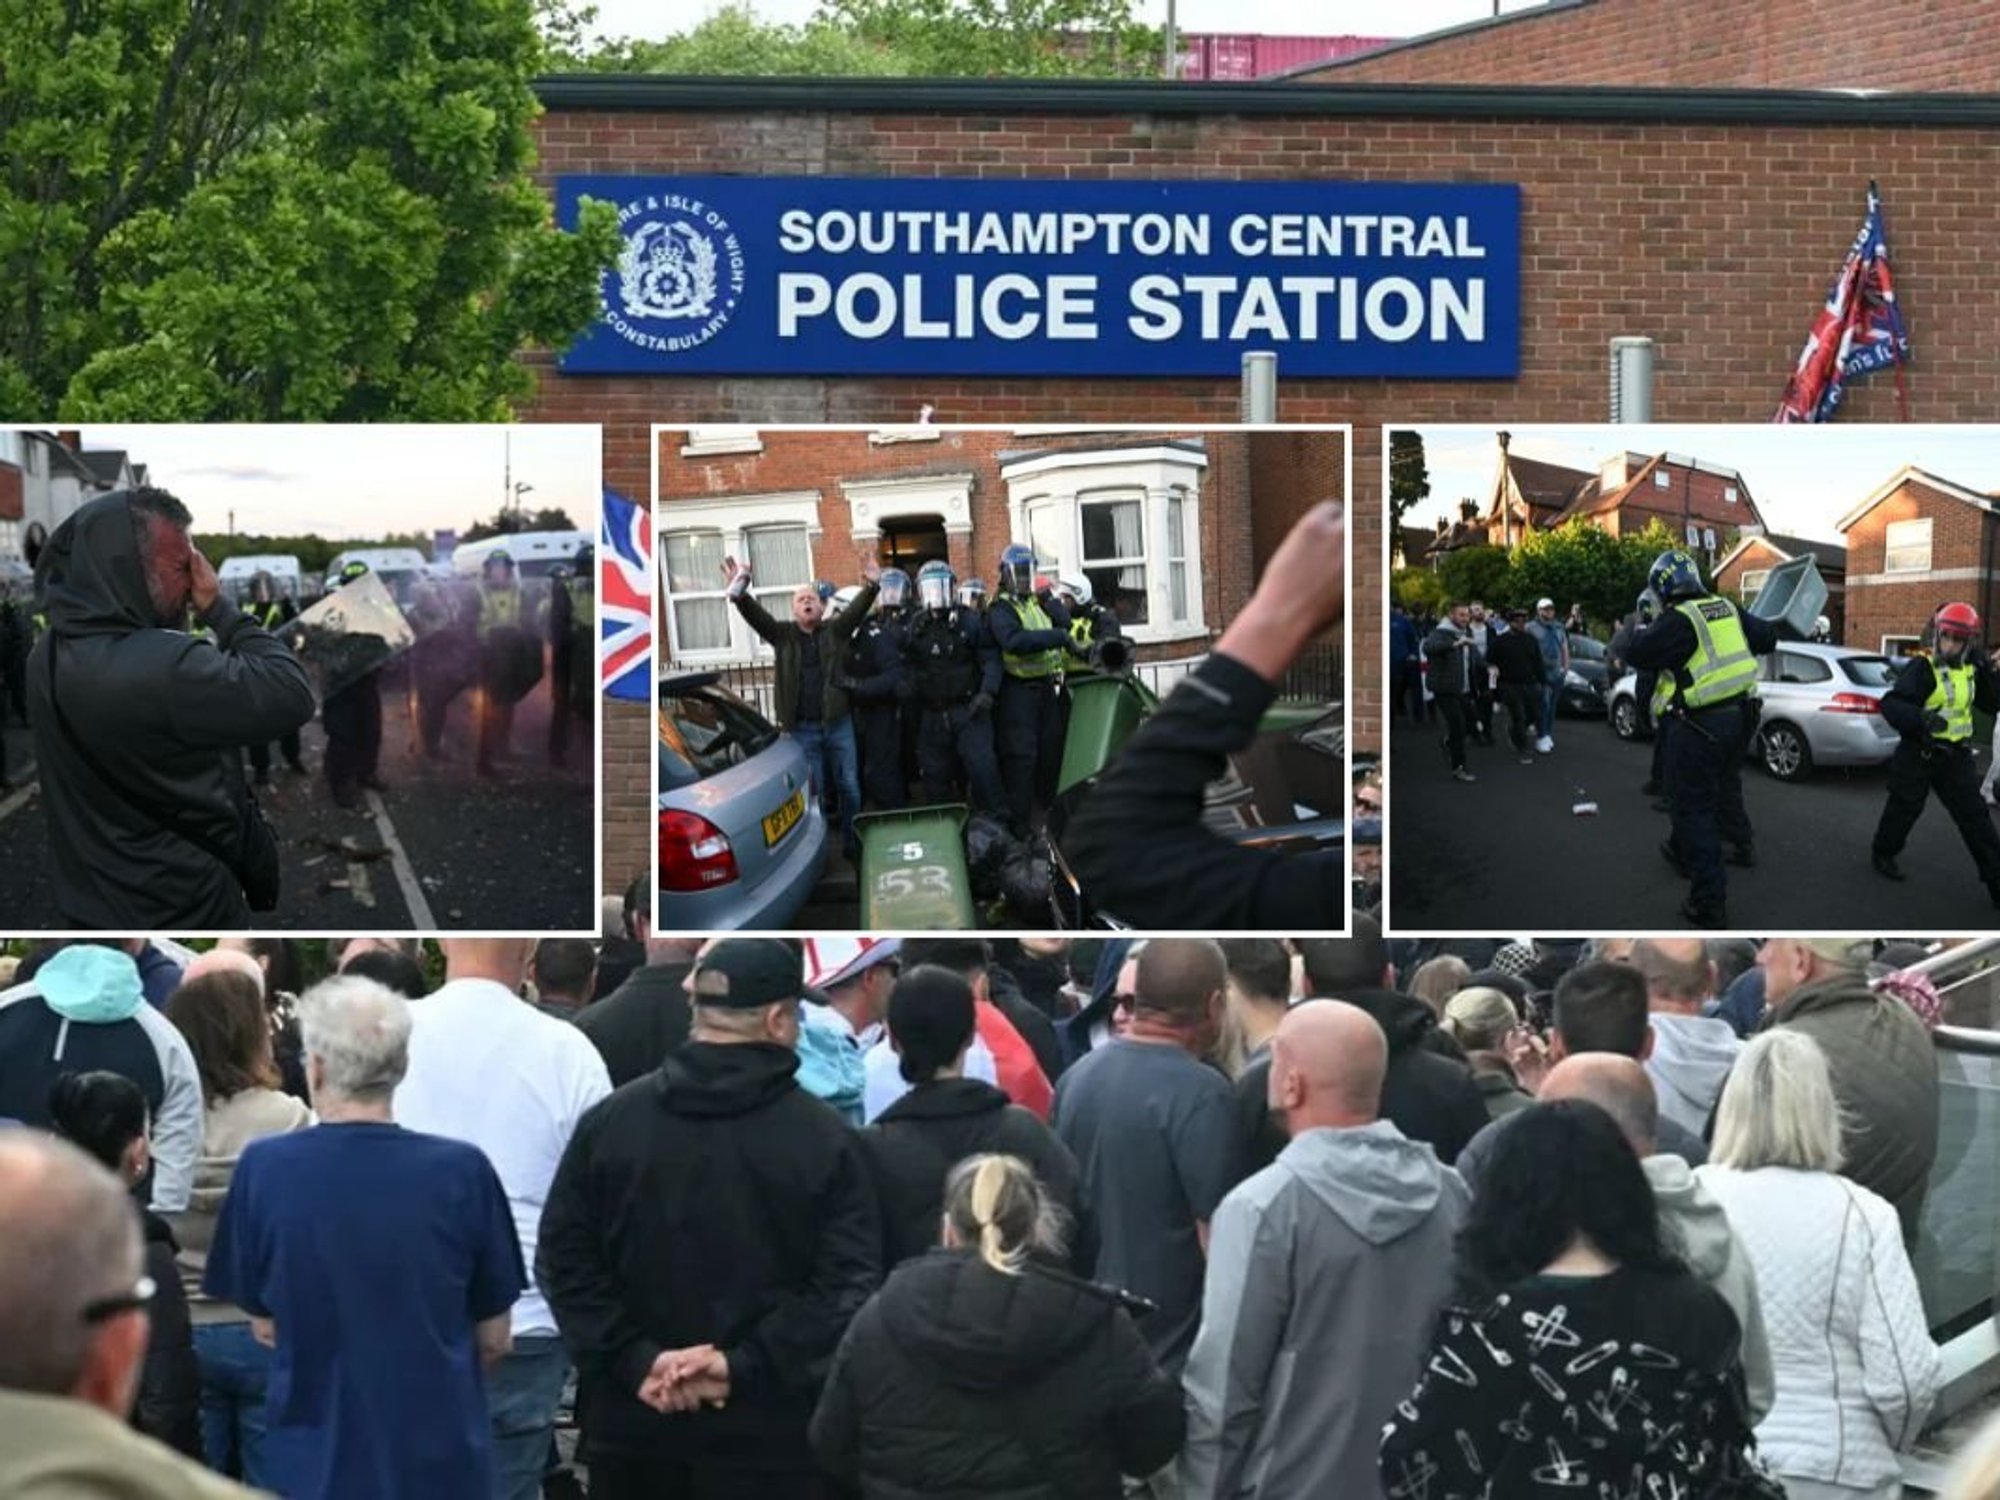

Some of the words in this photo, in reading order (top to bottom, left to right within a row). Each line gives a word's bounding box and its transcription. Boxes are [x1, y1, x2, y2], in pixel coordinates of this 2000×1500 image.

[646, 196, 659, 210] &
[665, 194, 704, 216] ISLE
[706, 211, 729, 232] OF
[724, 232, 745, 295] WIGHT
[779, 210, 1209, 255] SOUTHAMPTON
[1229, 214, 1485, 256] CENTRAL
[778, 272, 1097, 338] POLICE
[1128, 274, 1484, 341] STATION
[605, 310, 729, 352] CONSTABULARY
[903, 841, 924, 861] 5
[878, 865, 953, 898] 53
